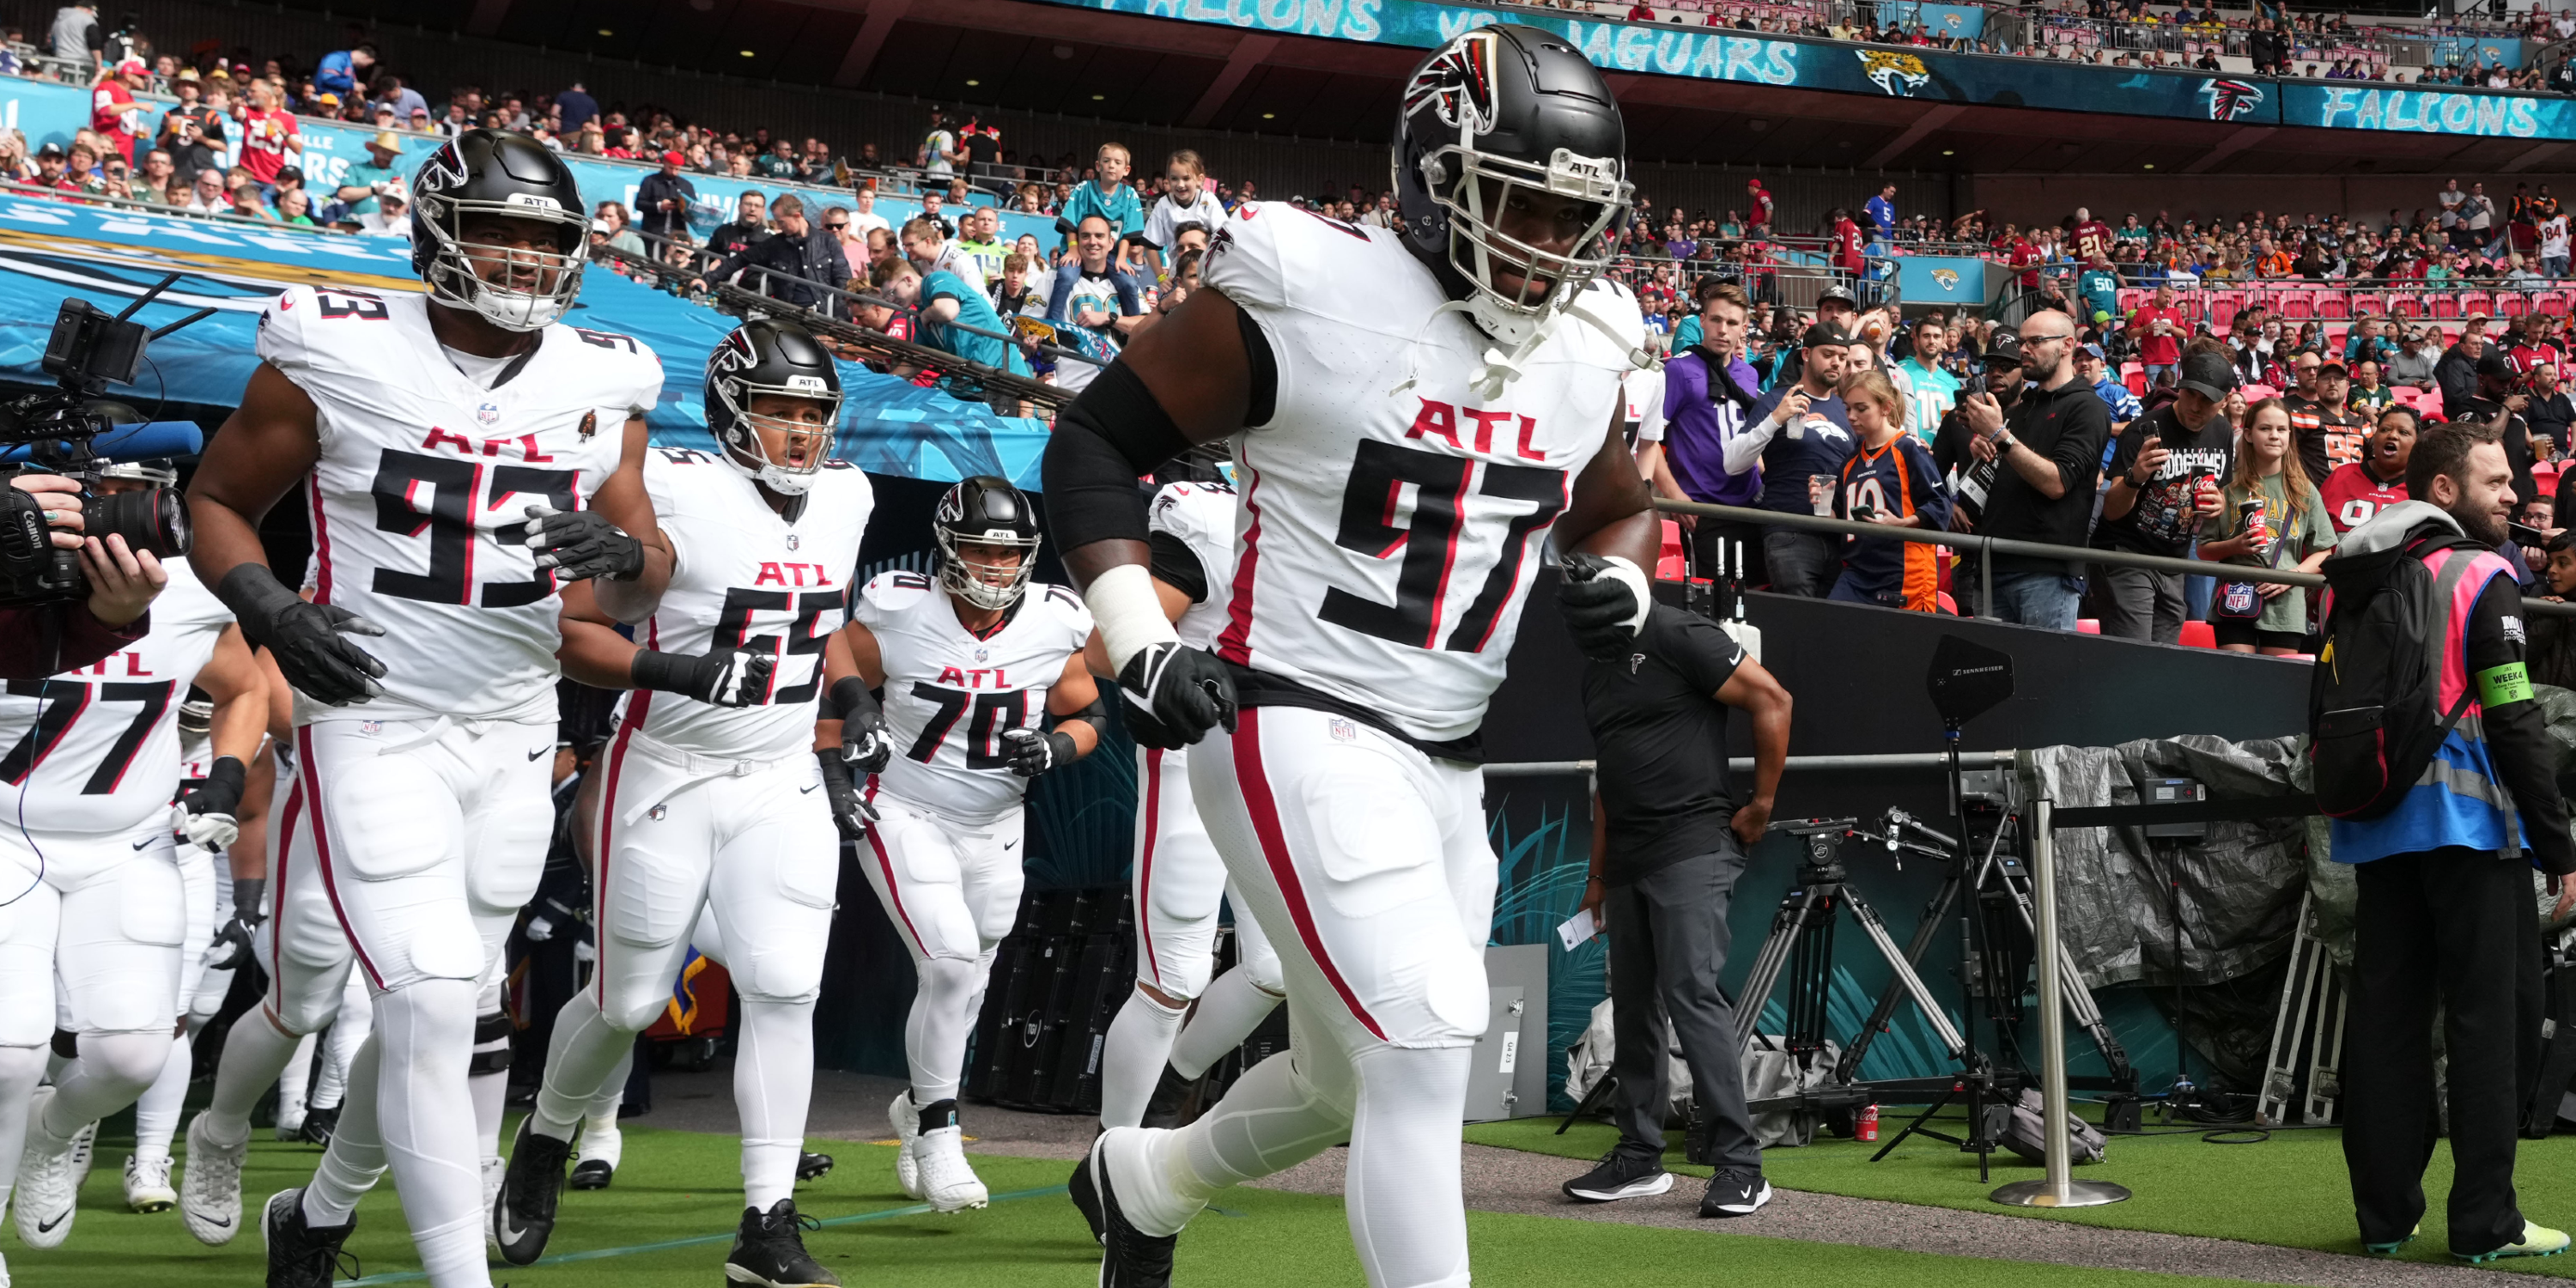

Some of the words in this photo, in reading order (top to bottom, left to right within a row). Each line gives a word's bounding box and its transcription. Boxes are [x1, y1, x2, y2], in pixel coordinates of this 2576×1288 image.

[1568, 20, 1798, 85] JAGUARS
[2323, 85, 2540, 138] FALCONS
[1569, 161, 1600, 179] ATL
[1883, 206, 1892, 222] 5
[2080, 226, 2097, 234] TAYLOR
[2544, 224, 2562, 240] 84
[2079, 234, 2103, 258] 21
[972, 254, 1001, 278] 14
[2093, 277, 2114, 292] 50
[798, 378, 820, 387] ATL
[479, 410, 499, 422] NFL
[1916, 389, 1947, 429] 10
[1404, 395, 1546, 462] ATL
[422, 426, 555, 464] ATL
[2324, 433, 2364, 471] 95
[1846, 477, 1887, 542] 10
[22, 510, 43, 550] Canon
[371, 447, 589, 609] 93
[992, 531, 1011, 539] ATL
[1317, 437, 1570, 654] 97
[754, 562, 833, 587] ATL
[2227, 595, 2249, 607] NFL
[936, 665, 1012, 690] ATL
[1962, 665, 2004, 675] SENNHEISER
[0, 676, 177, 796] 77
[905, 680, 1030, 770] 70
[1334, 726, 1353, 738] NFL
